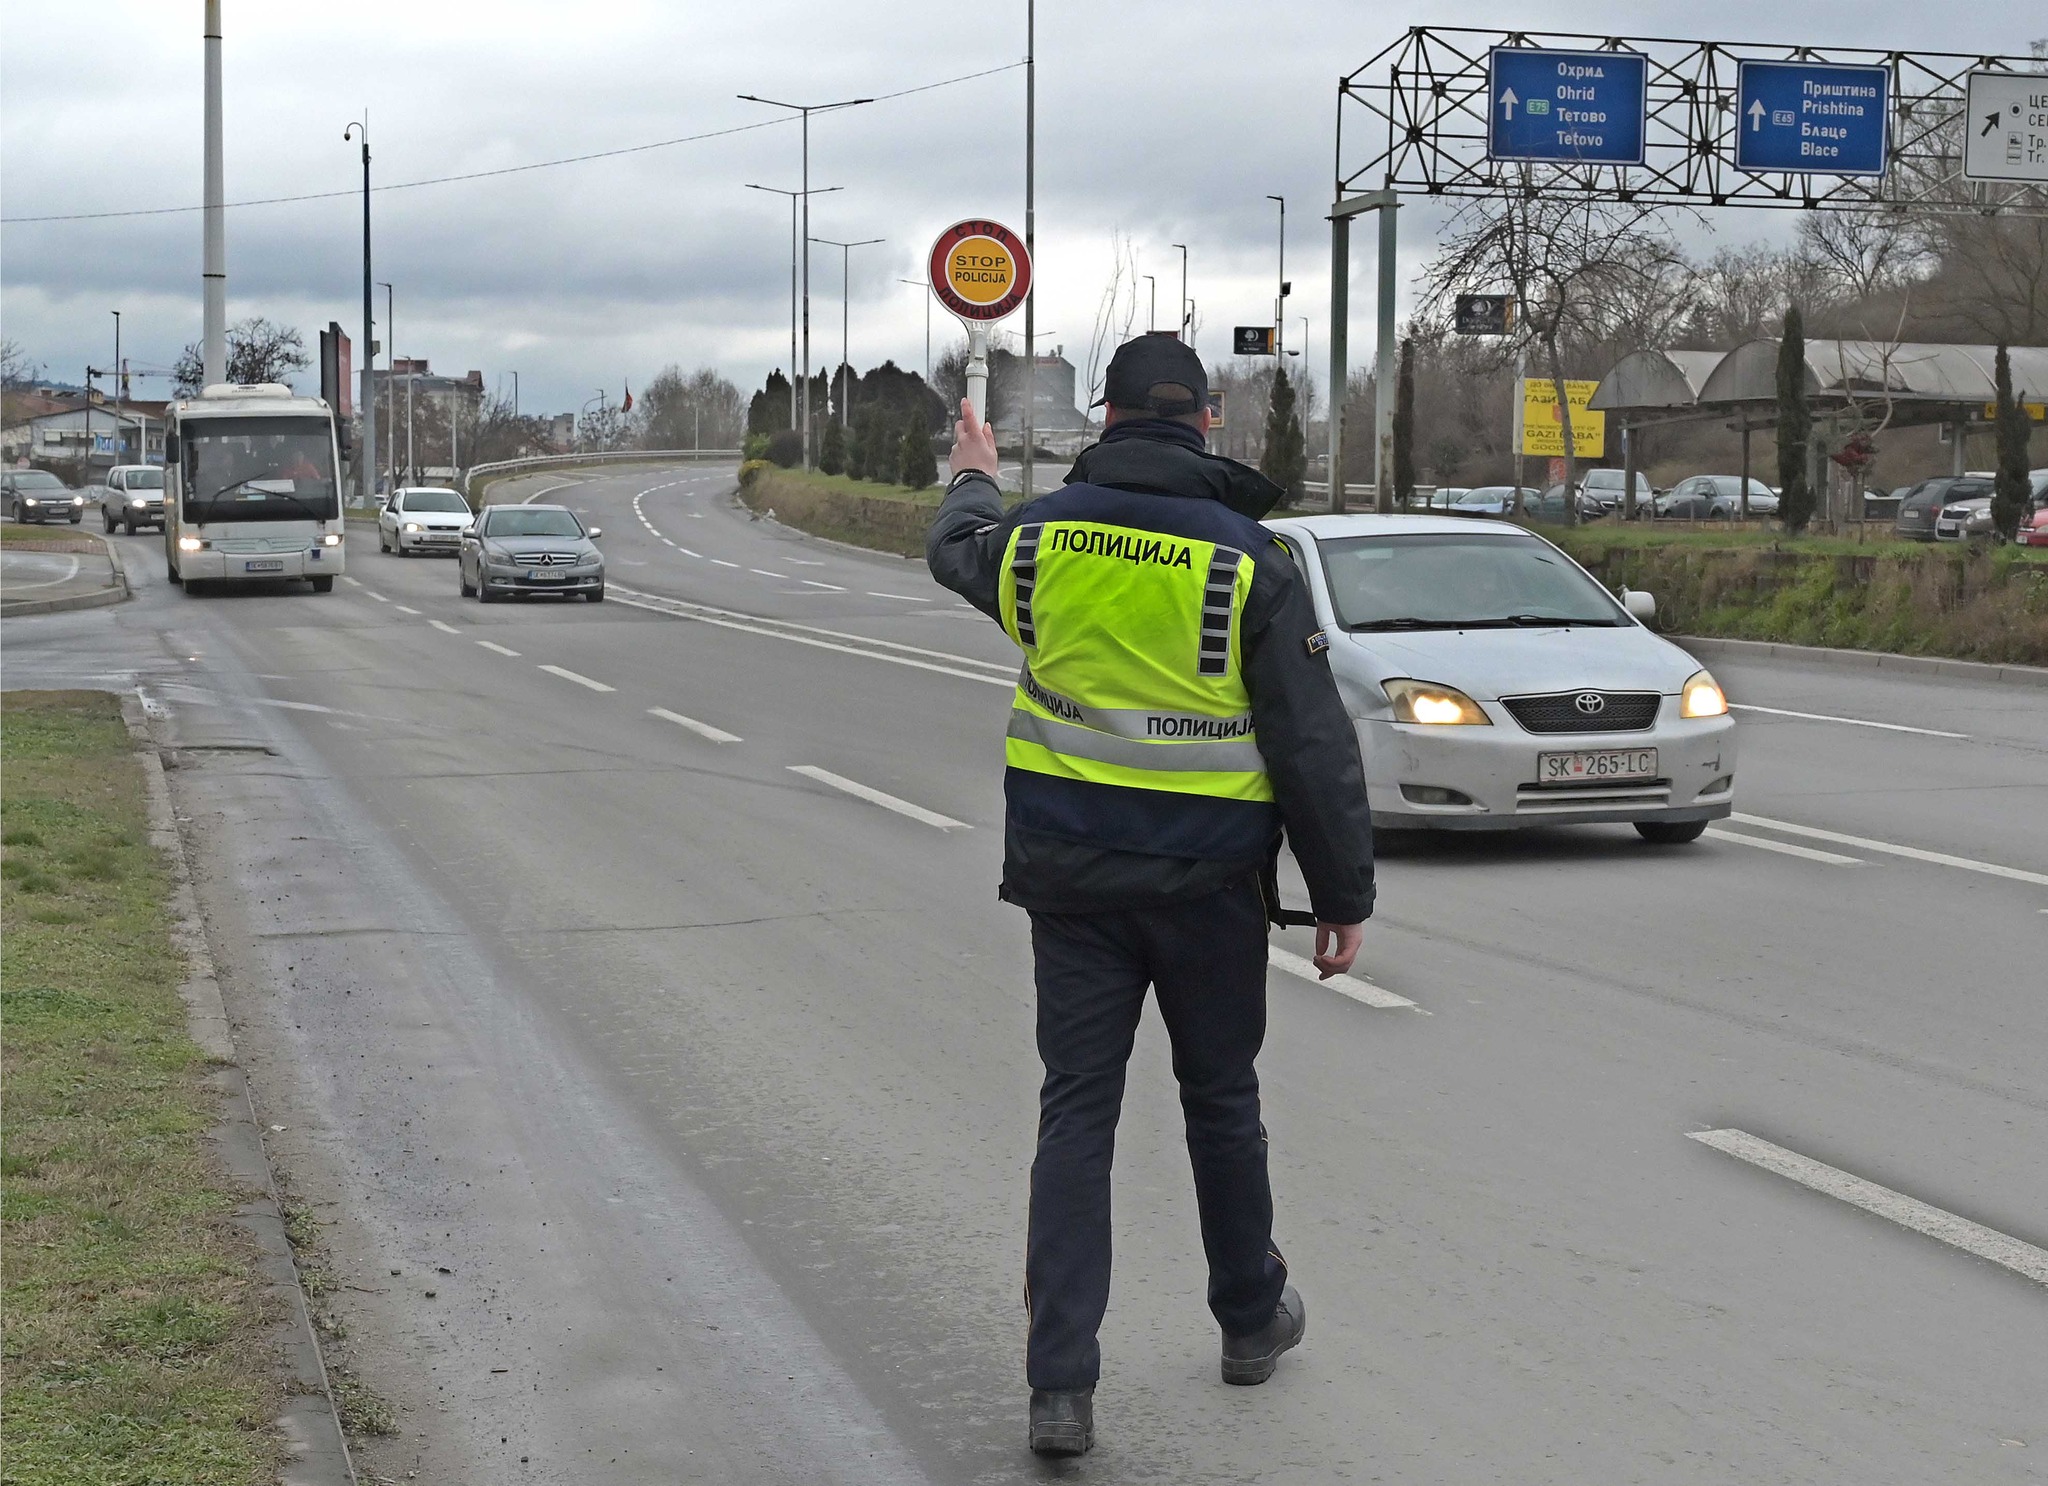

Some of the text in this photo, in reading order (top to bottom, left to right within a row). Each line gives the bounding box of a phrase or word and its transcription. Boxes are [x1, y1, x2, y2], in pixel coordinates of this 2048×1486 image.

[1557, 62, 1604, 80] Охрид
[1556, 85, 1595, 100] Ohrid
[1803, 80, 1876, 98] Приштина
[1556, 107, 1607, 122] Тетово
[1802, 100, 1864, 116] Prishtina
[1801, 122, 1847, 139] Блаце
[1556, 131, 1603, 146] Tetovo
[1800, 141, 1839, 156] Blace
[954, 221, 1008, 243] СТОП
[956, 255, 1006, 267] STOP
[955, 271, 1006, 283] POLICIJA
[938, 286, 1021, 318] ПОЛИЦИЈА
[1526, 430, 1556, 438] GAZI
[1531, 443, 1586, 451] GOODYE
[1051, 529, 1191, 569] ПОЛИЦИЈА
[1548, 757, 1570, 776] SK
